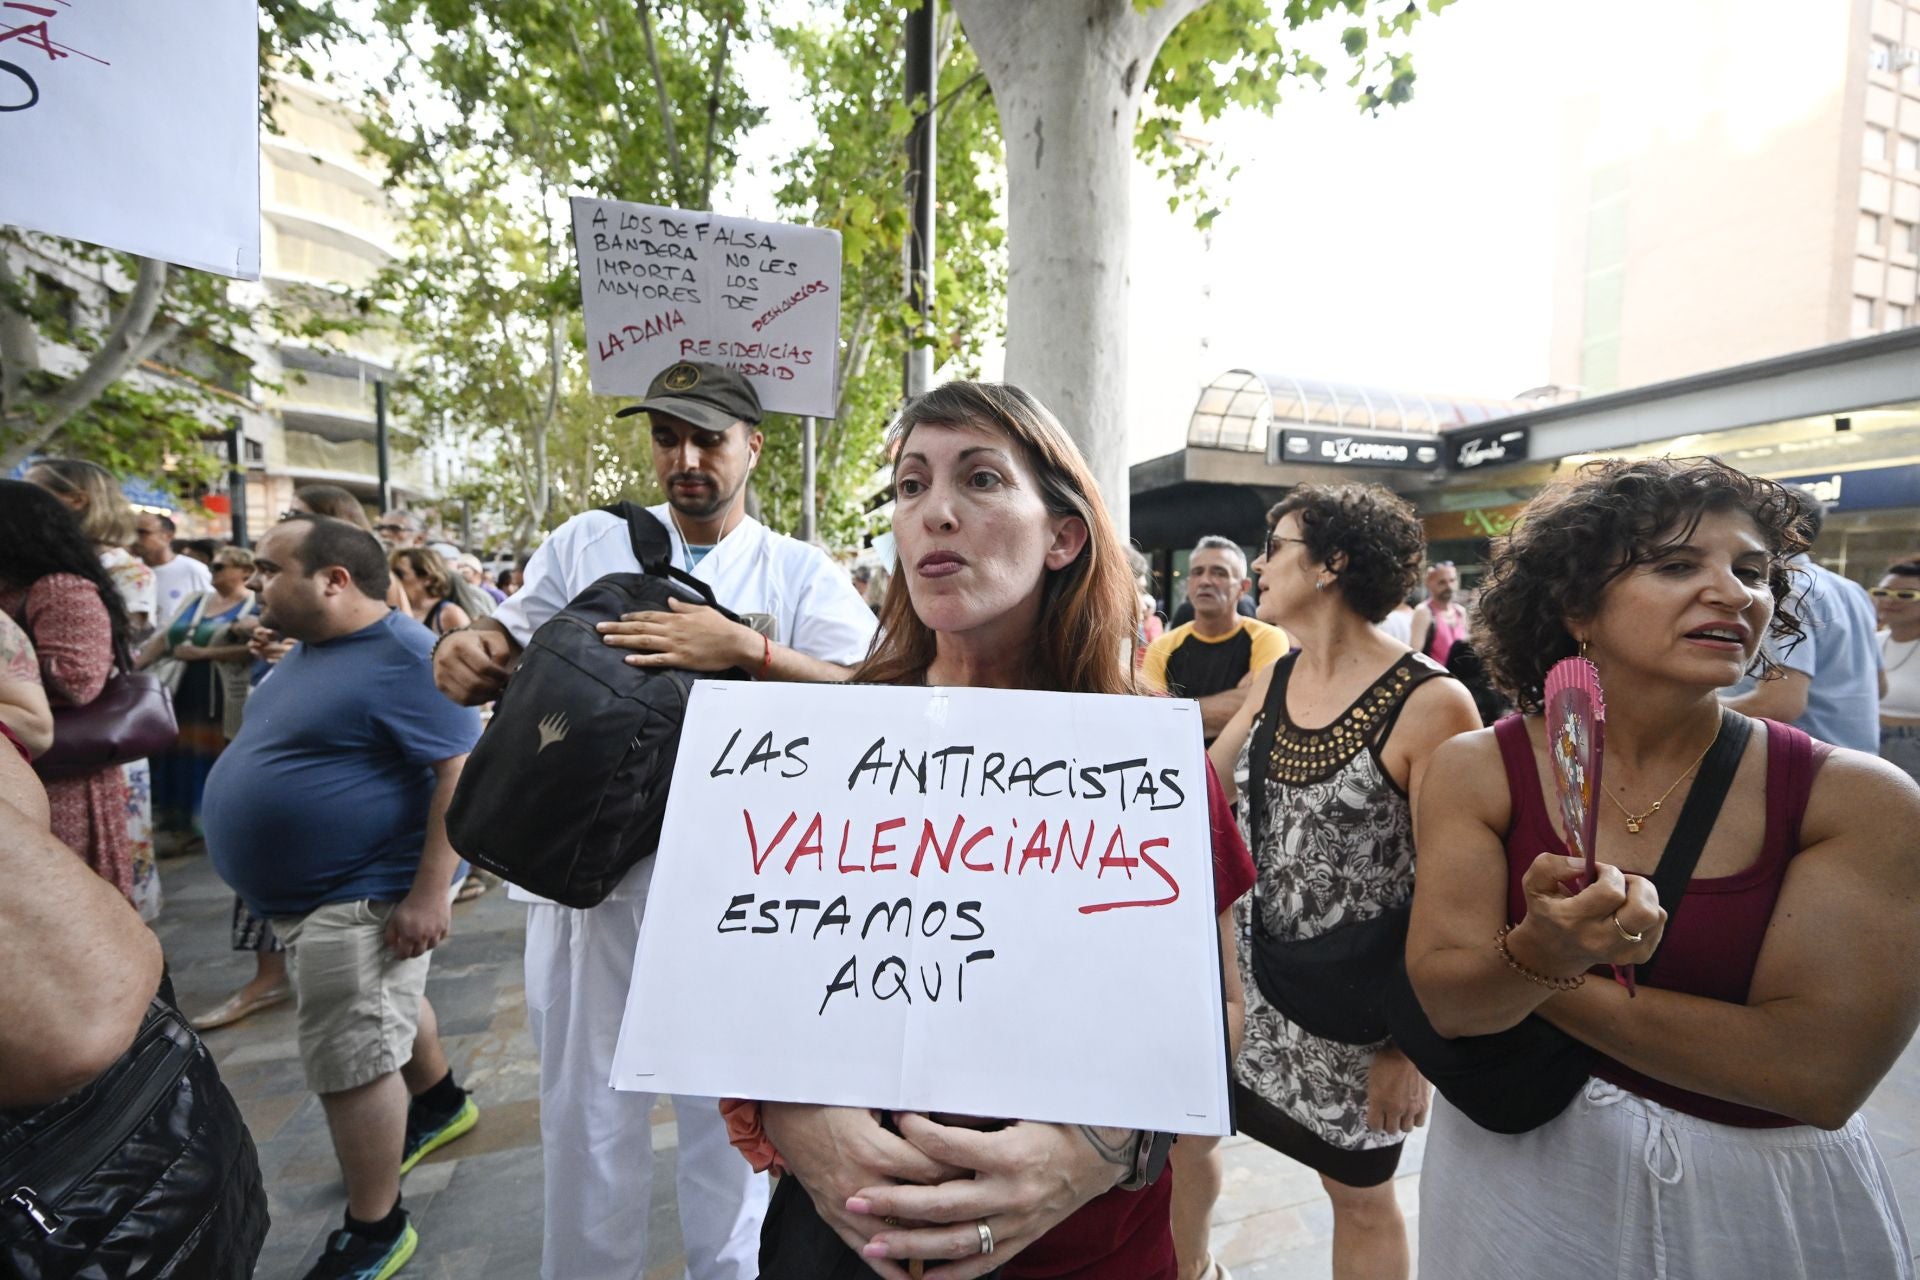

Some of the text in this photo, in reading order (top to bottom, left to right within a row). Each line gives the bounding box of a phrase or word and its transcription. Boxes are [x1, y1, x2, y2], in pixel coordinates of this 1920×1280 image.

[592, 207, 777, 252] A LOS DE FALSA
[594, 233, 698, 260] BANDERA
[597, 258, 696, 283] IMPORTA
[726, 252, 797, 276] NO LES
[598, 278, 702, 304] MAYORES
[727, 275, 759, 291] LOS
[721, 295, 758, 311] DE
[598, 308, 686, 362] LA DANA
[710, 729, 809, 778] LAS
[717, 893, 985, 940] ESTAMOS
